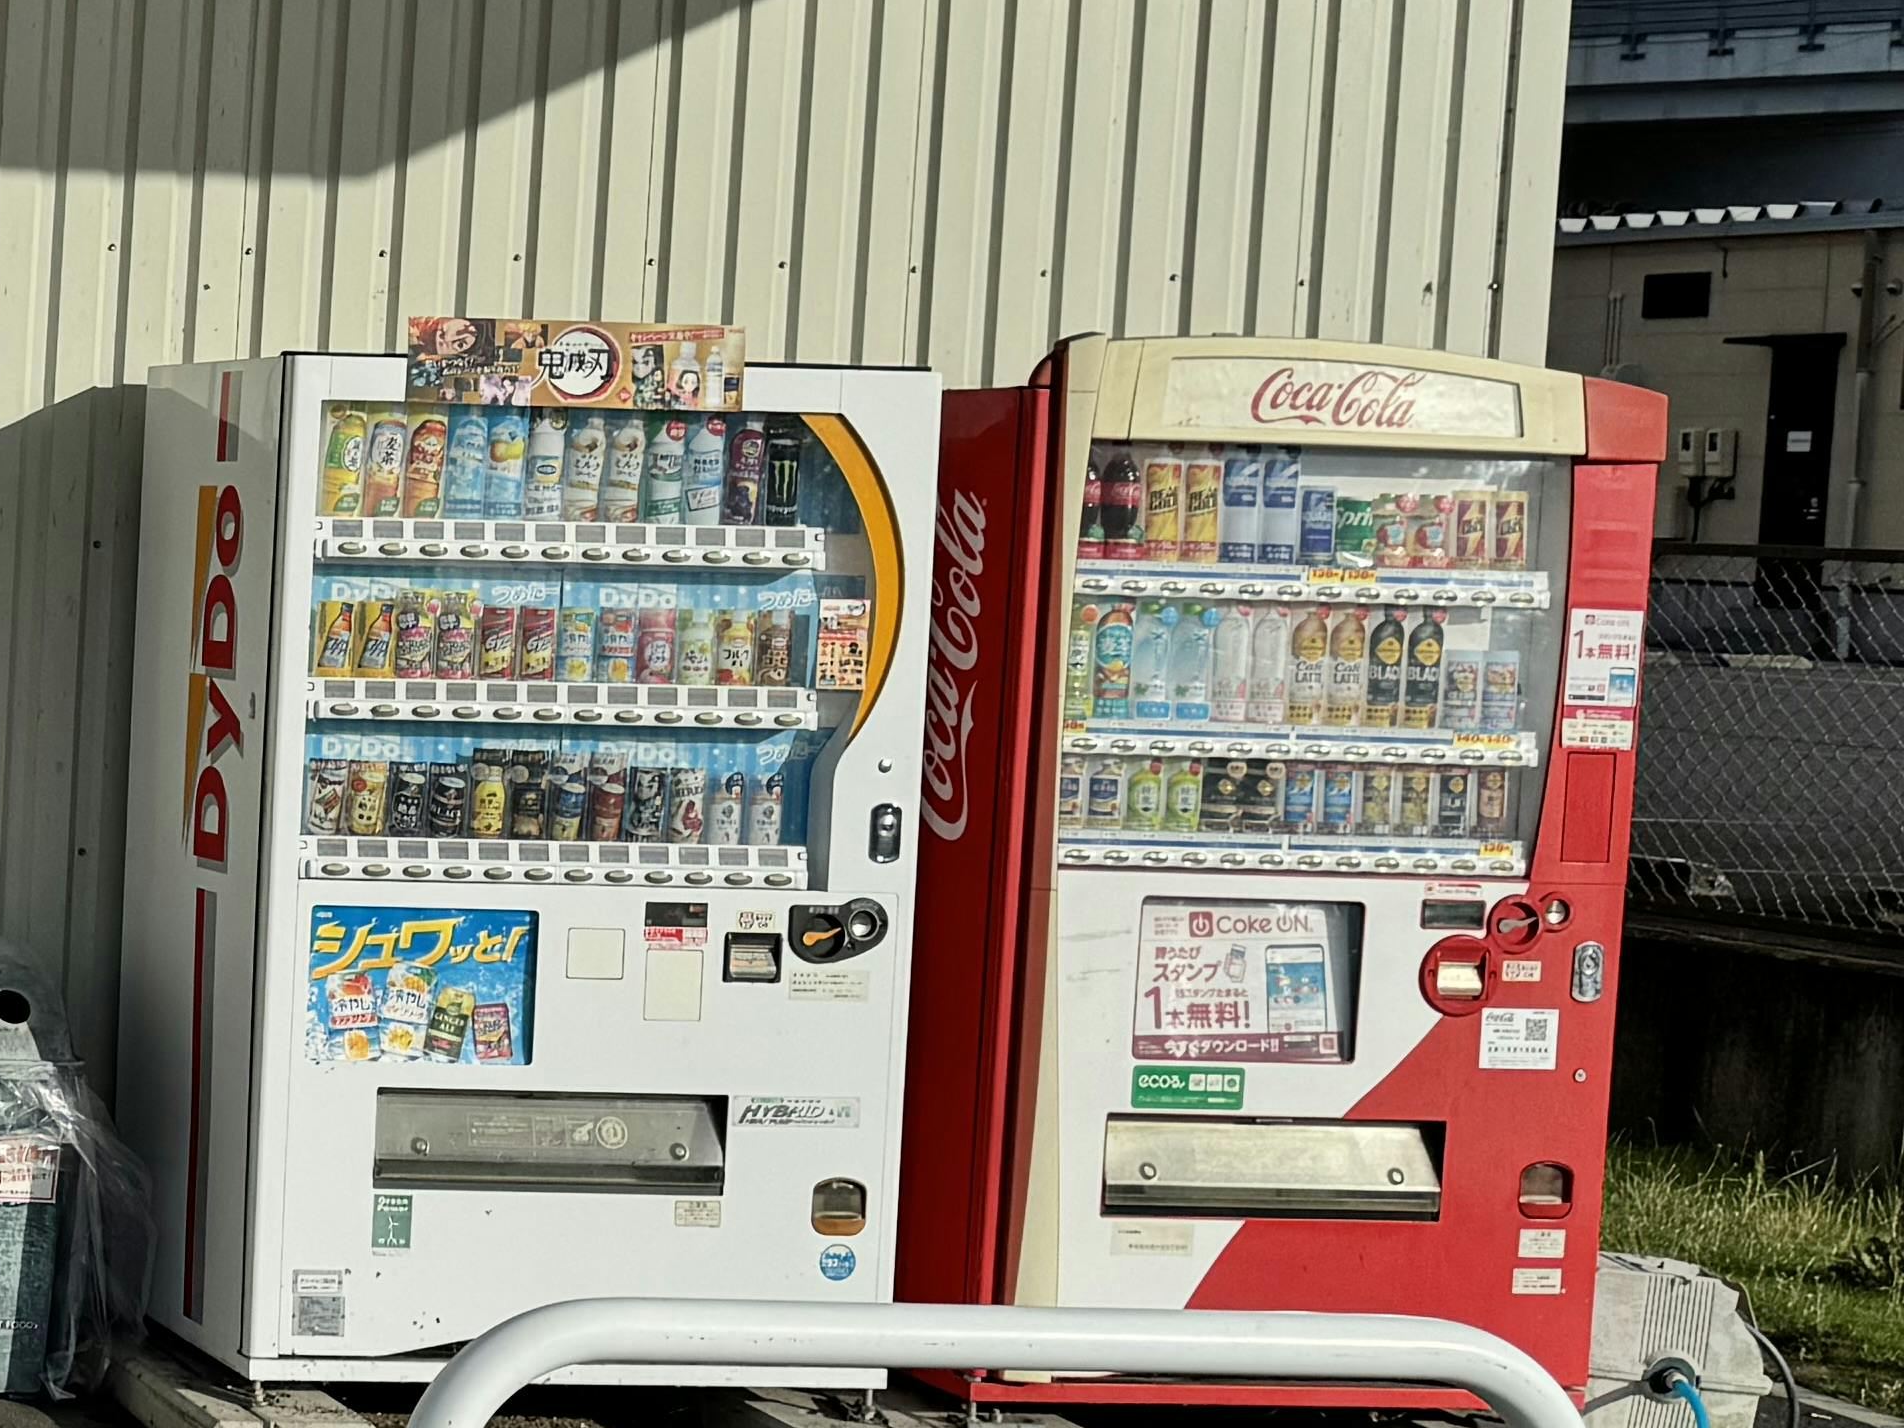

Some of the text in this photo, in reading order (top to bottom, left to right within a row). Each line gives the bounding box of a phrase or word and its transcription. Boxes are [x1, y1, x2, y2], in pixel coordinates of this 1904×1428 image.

[1216, 914, 1273, 934] Coke
[1152, 960, 1222, 983] スタンプ
[1143, 986, 1250, 1030] 1本無料!
